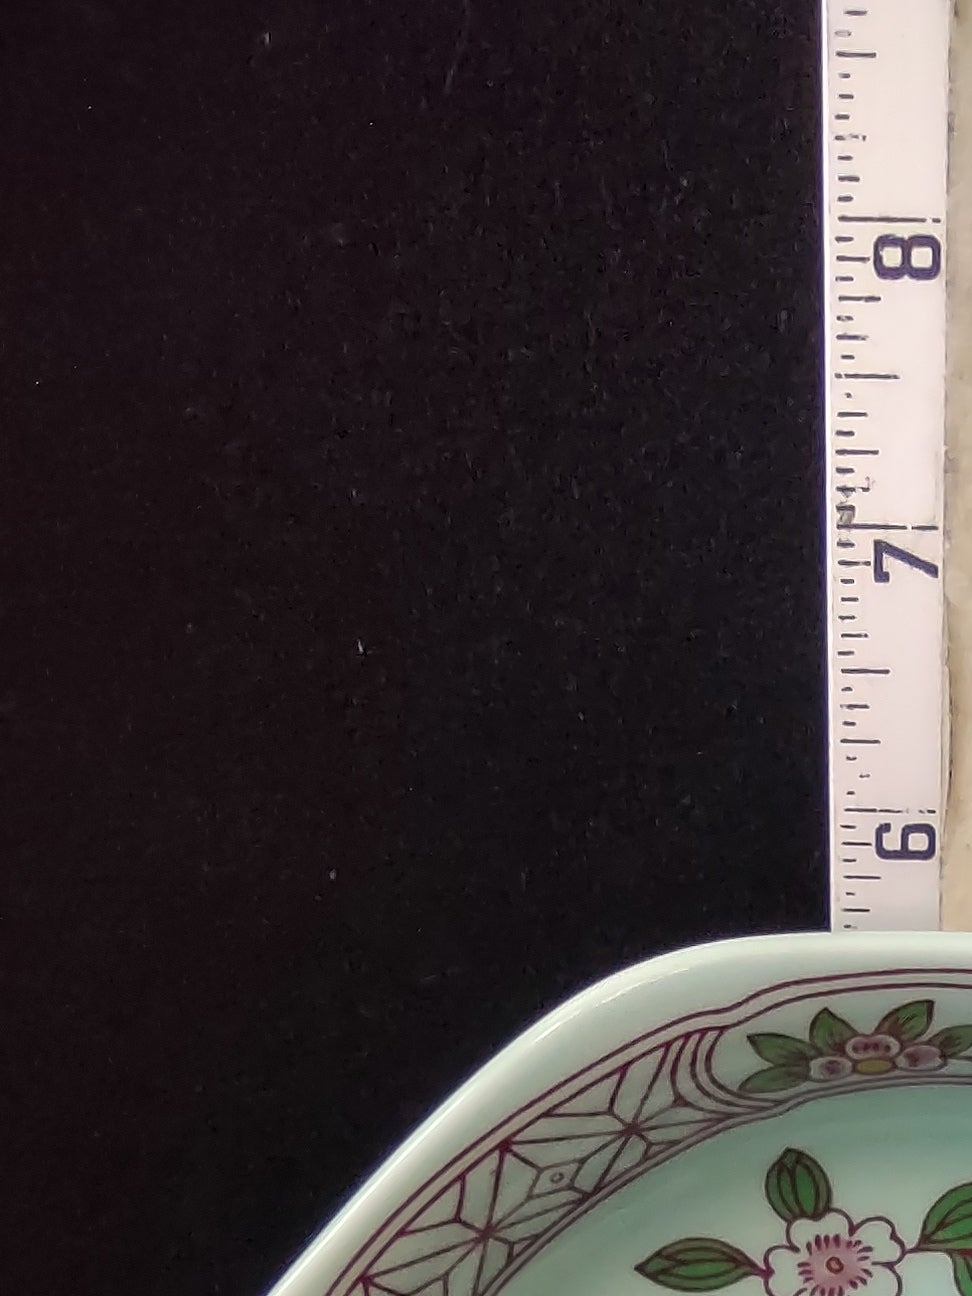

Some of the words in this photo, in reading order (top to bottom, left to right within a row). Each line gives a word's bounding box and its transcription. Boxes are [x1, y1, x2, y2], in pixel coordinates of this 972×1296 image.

[873, 234, 941, 281] 8
[873, 539, 939, 583] 7
[875, 822, 936, 861] 6
